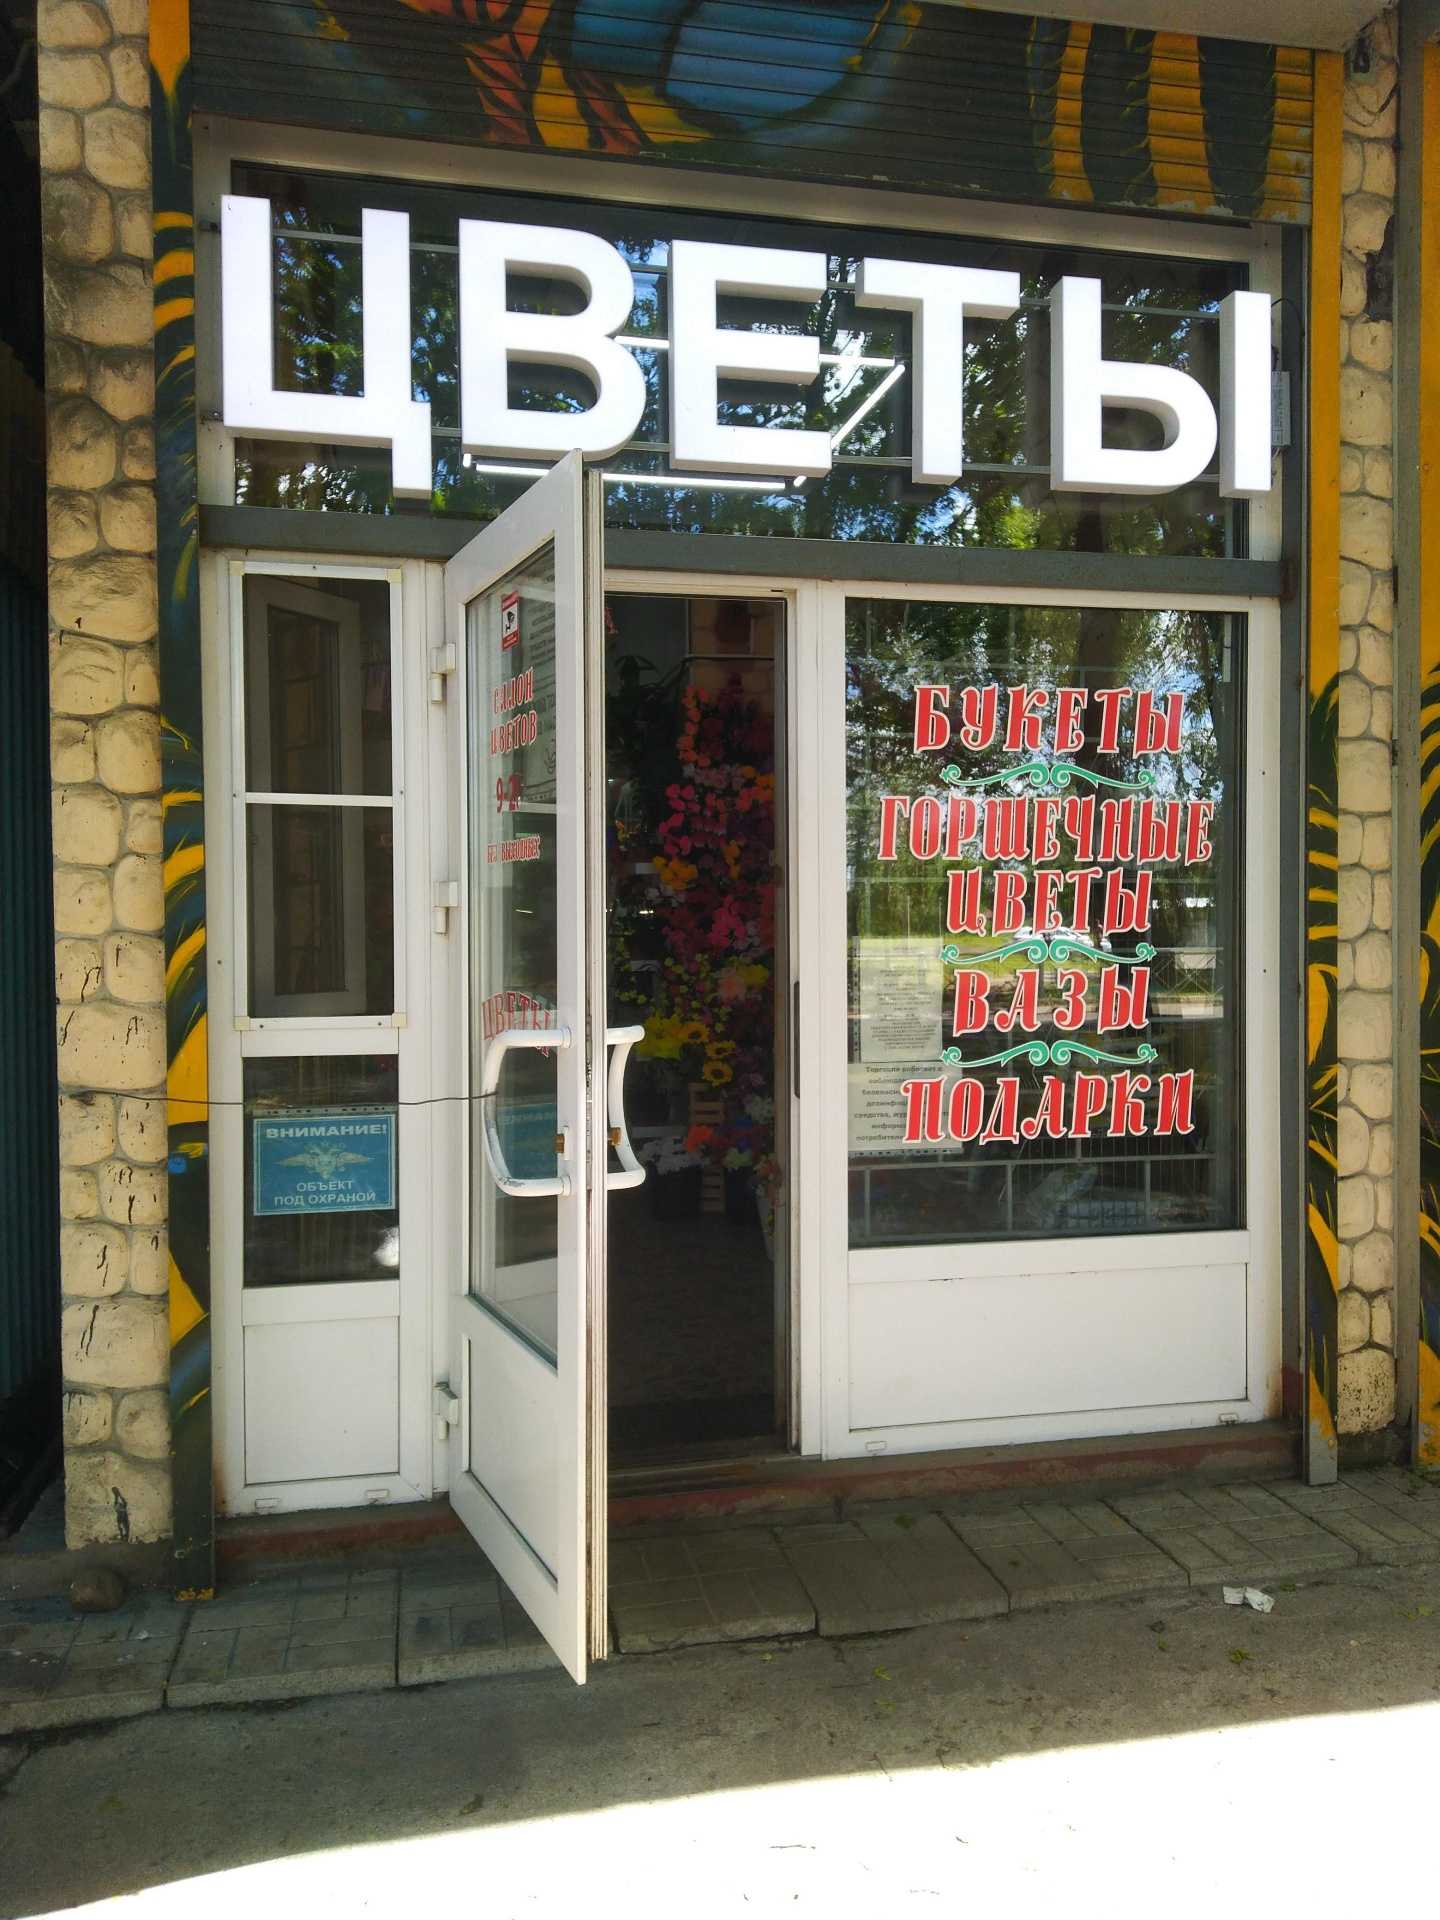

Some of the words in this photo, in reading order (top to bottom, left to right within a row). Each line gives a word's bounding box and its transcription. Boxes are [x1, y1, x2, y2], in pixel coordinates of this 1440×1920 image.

[221, 195, 1272, 500] ЦВЕТЫ
[493, 667, 533, 715] САЛОН
[913, 683, 1185, 756] БУКЕТЫ
[489, 710, 537, 757] ЦВЕТОВ
[878, 795, 1214, 866] ГОРШЕЧНЫЕ
[946, 867, 1153, 937] ЦВЕТЫ
[953, 965, 1151, 1037] ВАЗЫ
[265, 1124, 388, 1139] ВНИМАНИЕ!
[901, 1068, 1197, 1146] ПОДАРКИ
[274, 1194, 306, 1207] ПОД
[307, 1190, 377, 1205] ОХРАНОЙ
[296, 1179, 353, 1193] ОБЪЕКТ
